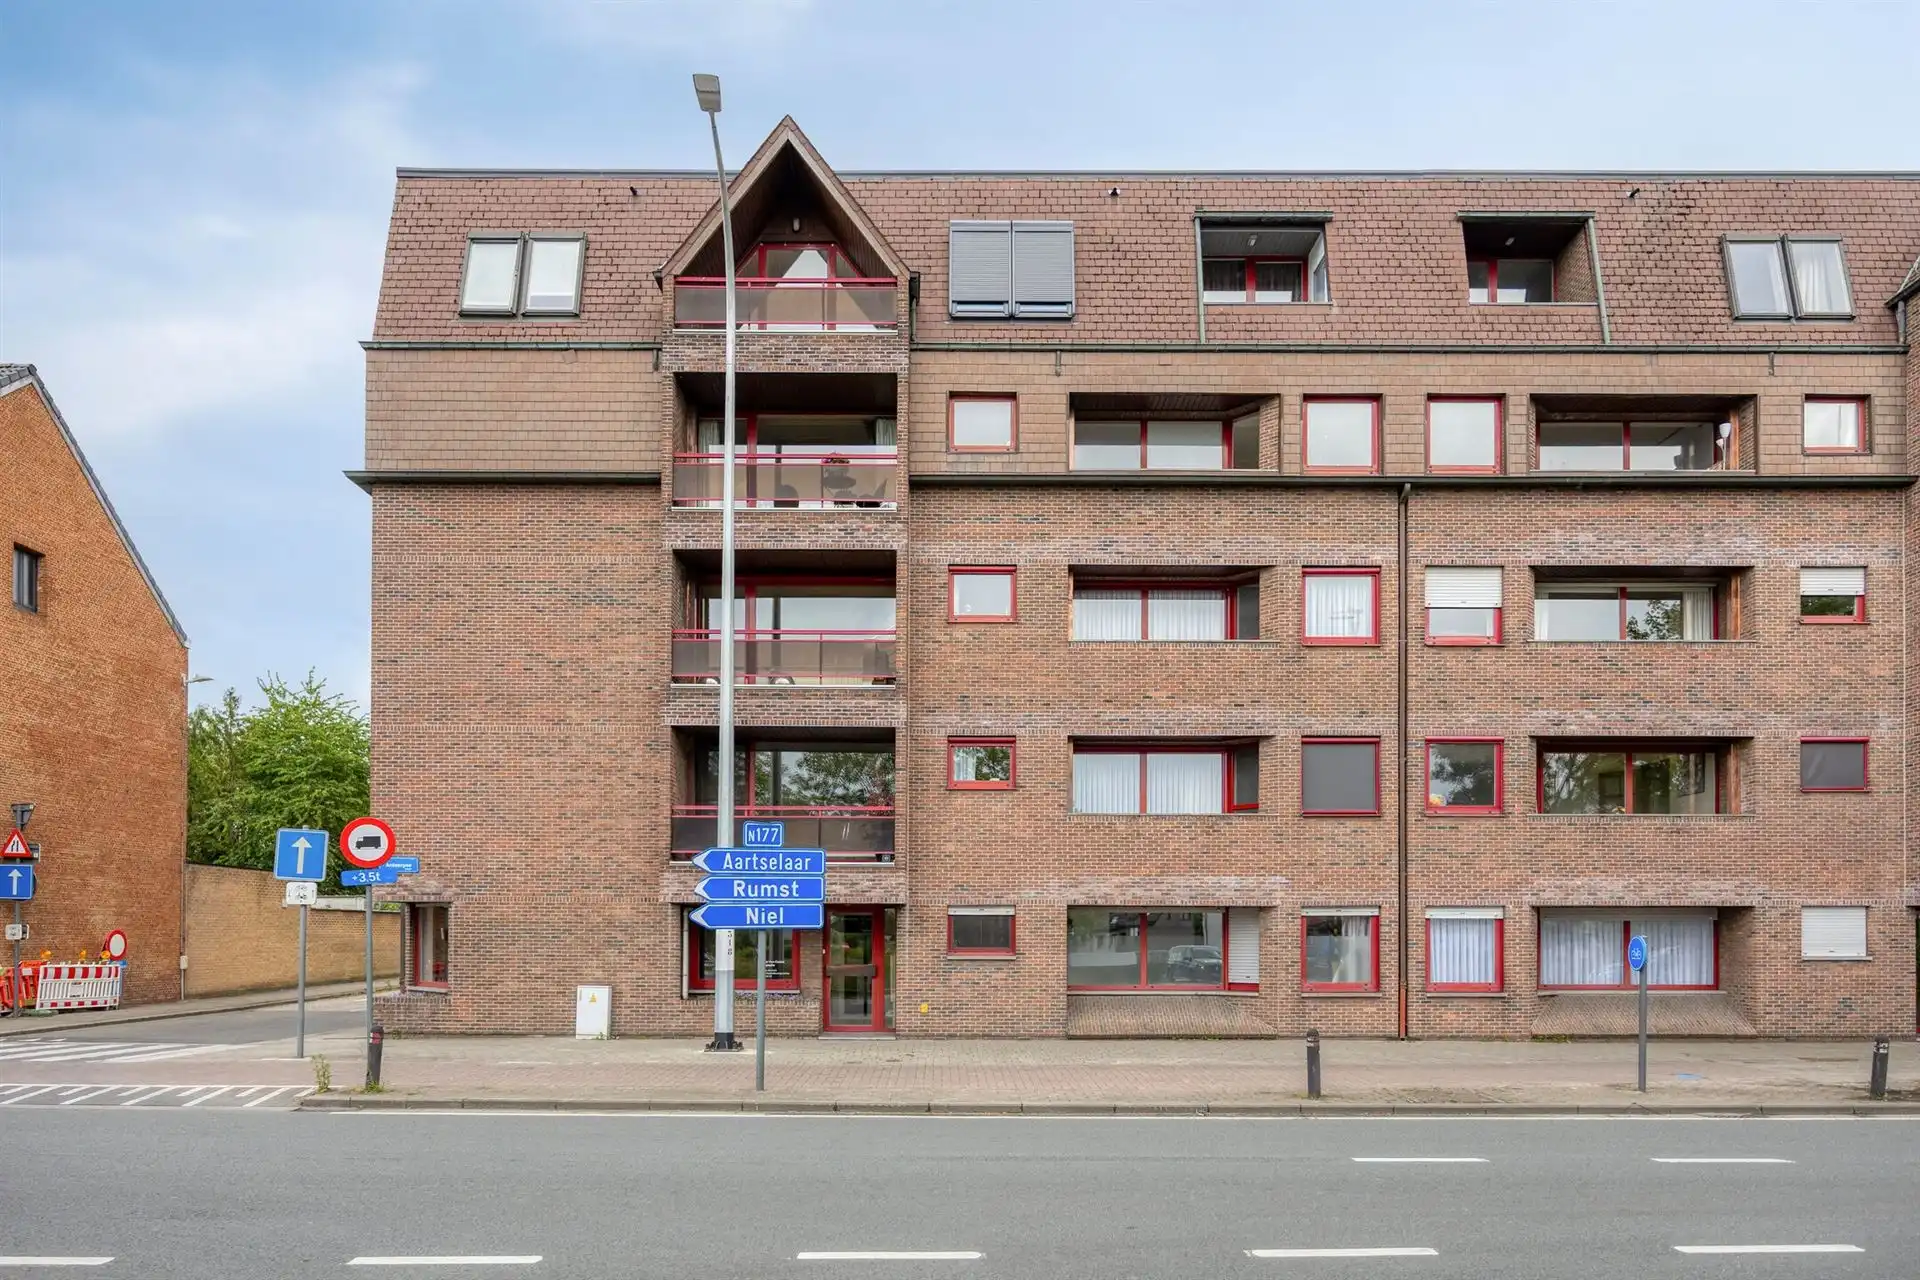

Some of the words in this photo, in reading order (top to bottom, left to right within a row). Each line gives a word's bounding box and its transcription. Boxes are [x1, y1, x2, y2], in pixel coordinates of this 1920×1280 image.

[748, 827, 779, 842] N177
[723, 852, 811, 870] Aartselaar
[733, 880, 799, 897] Rumst
[746, 907, 784, 924] Niel
